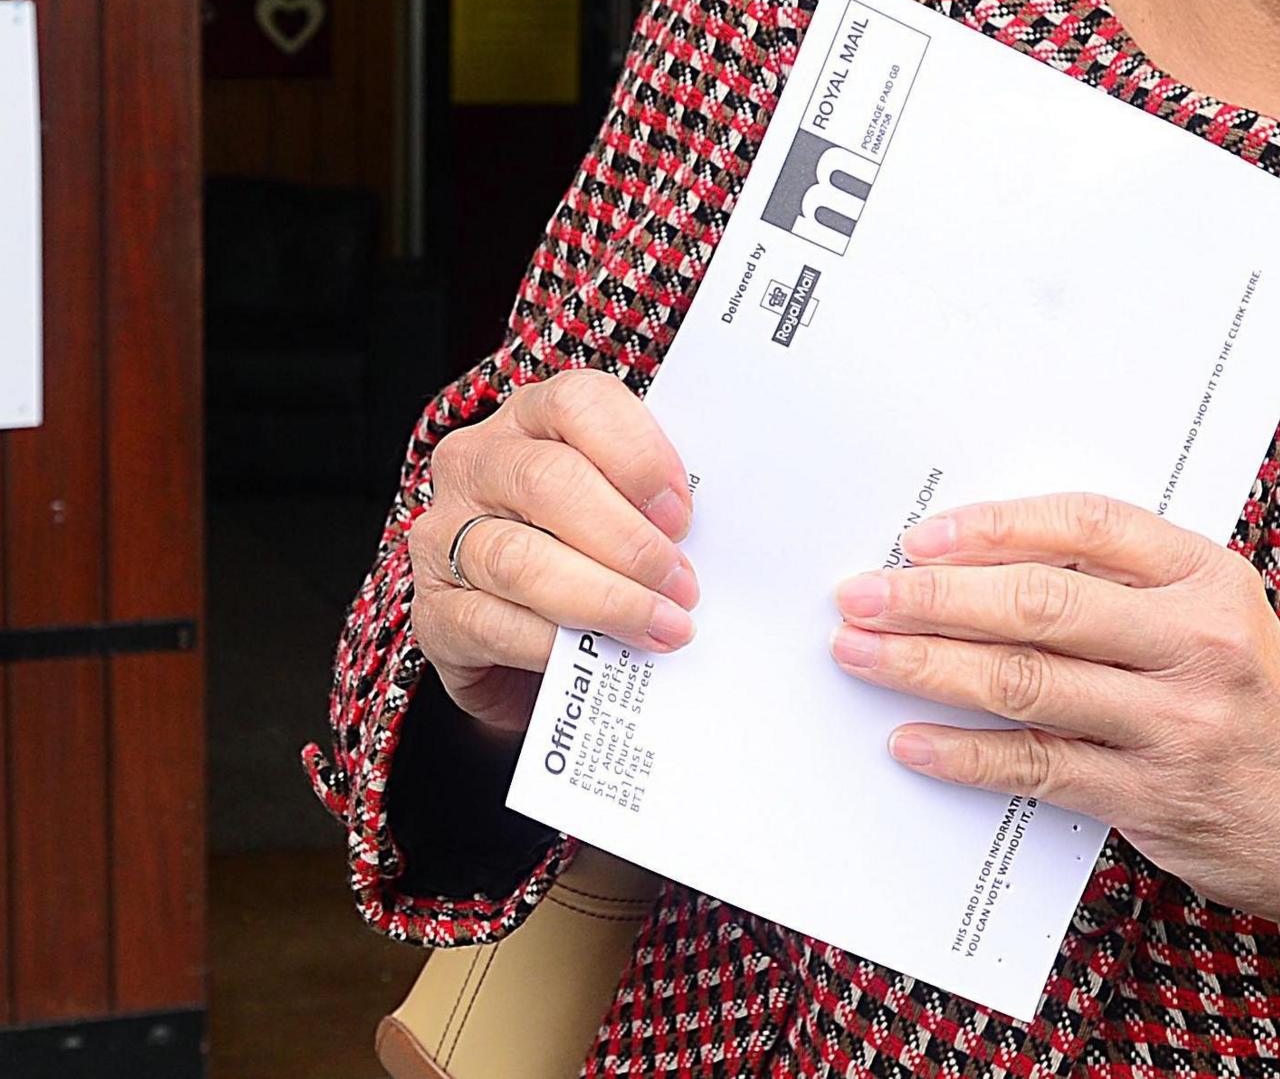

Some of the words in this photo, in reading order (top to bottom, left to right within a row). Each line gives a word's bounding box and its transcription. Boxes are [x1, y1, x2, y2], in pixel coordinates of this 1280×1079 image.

[813, 69, 848, 130] ROYAL
[840, 19, 868, 63] MAIL
[861, 104, 885, 150] POSTAGE
[880, 80, 893, 103] PAID
[889, 65, 900, 79] GB
[721, 262, 756, 324] Delivered
[750, 243, 766, 260] by
[774, 299, 804, 343] Royal
[791, 268, 816, 303] Mail
[1163, 454, 1187, 500] STATION
[1184, 428, 1197, 453] AND
[1193, 392, 1211, 426] SHOW
[1208, 381, 1216, 390] IT
[1212, 364, 1223, 377] TO
[1219, 341, 1232, 360] THE
[1228, 306, 1246, 339] CLERK
[916, 468, 943, 510] JOHN
[545, 664, 593, 775] Official
[579, 629, 606, 658] P
[570, 733, 591, 785] Return
[589, 664, 612, 724] Address
[582, 712, 611, 791] Electoral
[608, 647, 633, 702] Office
[594, 781, 606, 796] St
[602, 718, 623, 770] Anne's
[620, 664, 639, 708] House
[605, 784, 618, 800] 15
[614, 723, 635, 775] Church
[632, 660, 654, 713] Street
[618, 747, 643, 807] Belfast
[630, 787, 645, 812] BT1
[952, 928, 967, 951] THIS
[962, 896, 979, 926] CARD
[974, 884, 984, 894] IS
[979, 860, 994, 882] FOR
[989, 795, 1023, 858] INFORMATI
[965, 934, 980, 956] YOU
[976, 909, 990, 932] CAN
[985, 878, 1003, 905] VOTE
[998, 824, 1025, 875] WITHOUT
[1020, 811, 1034, 823] IT,
